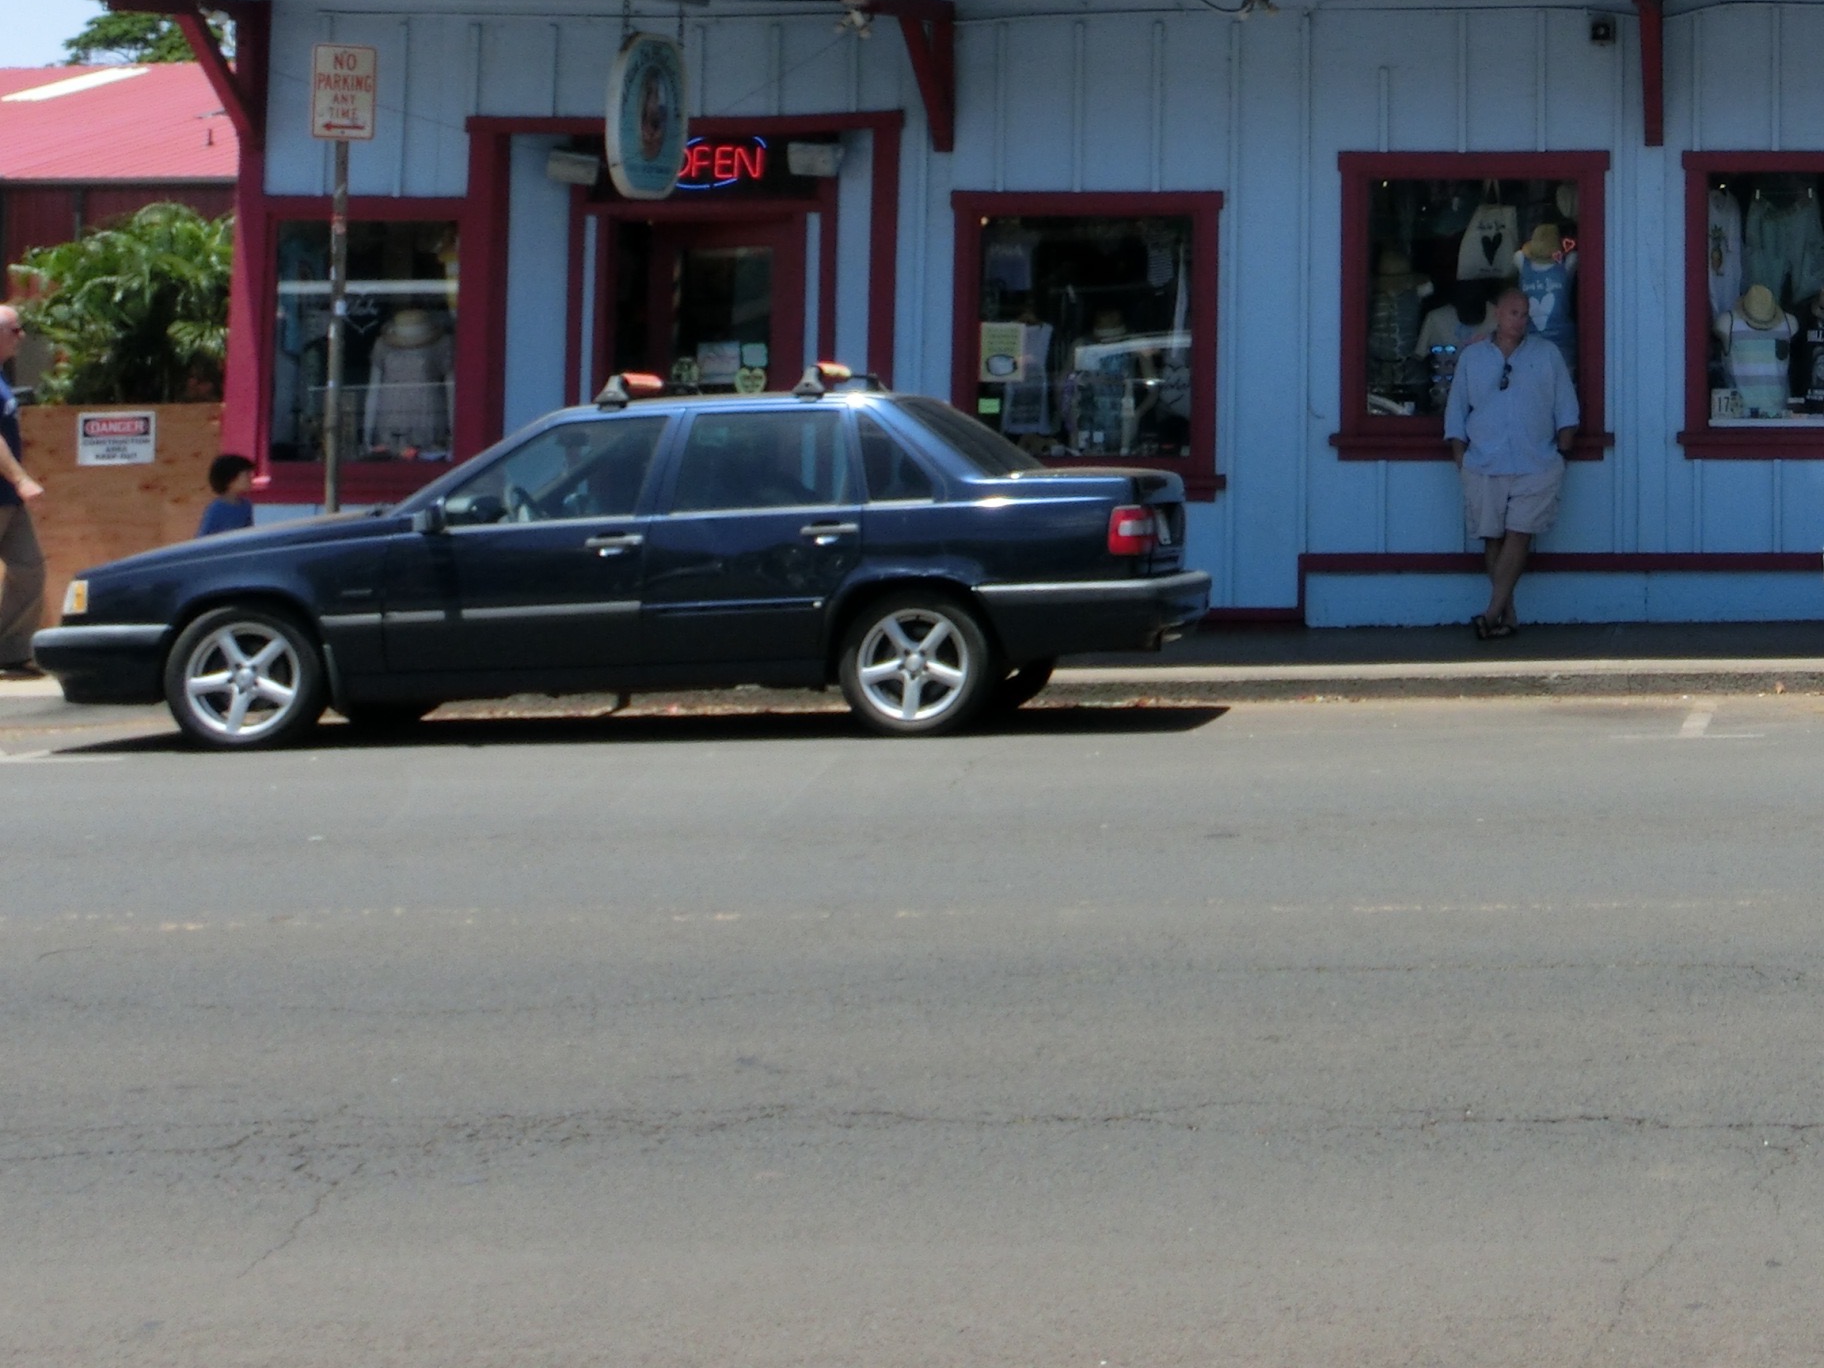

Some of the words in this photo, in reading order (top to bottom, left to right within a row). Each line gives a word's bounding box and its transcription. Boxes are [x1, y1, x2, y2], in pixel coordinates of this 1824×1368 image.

[333, 53, 357, 71] NO
[317, 73, 373, 92] PARKING
[333, 93, 355, 104] ANY
[90, 419, 146, 434] DANGER
